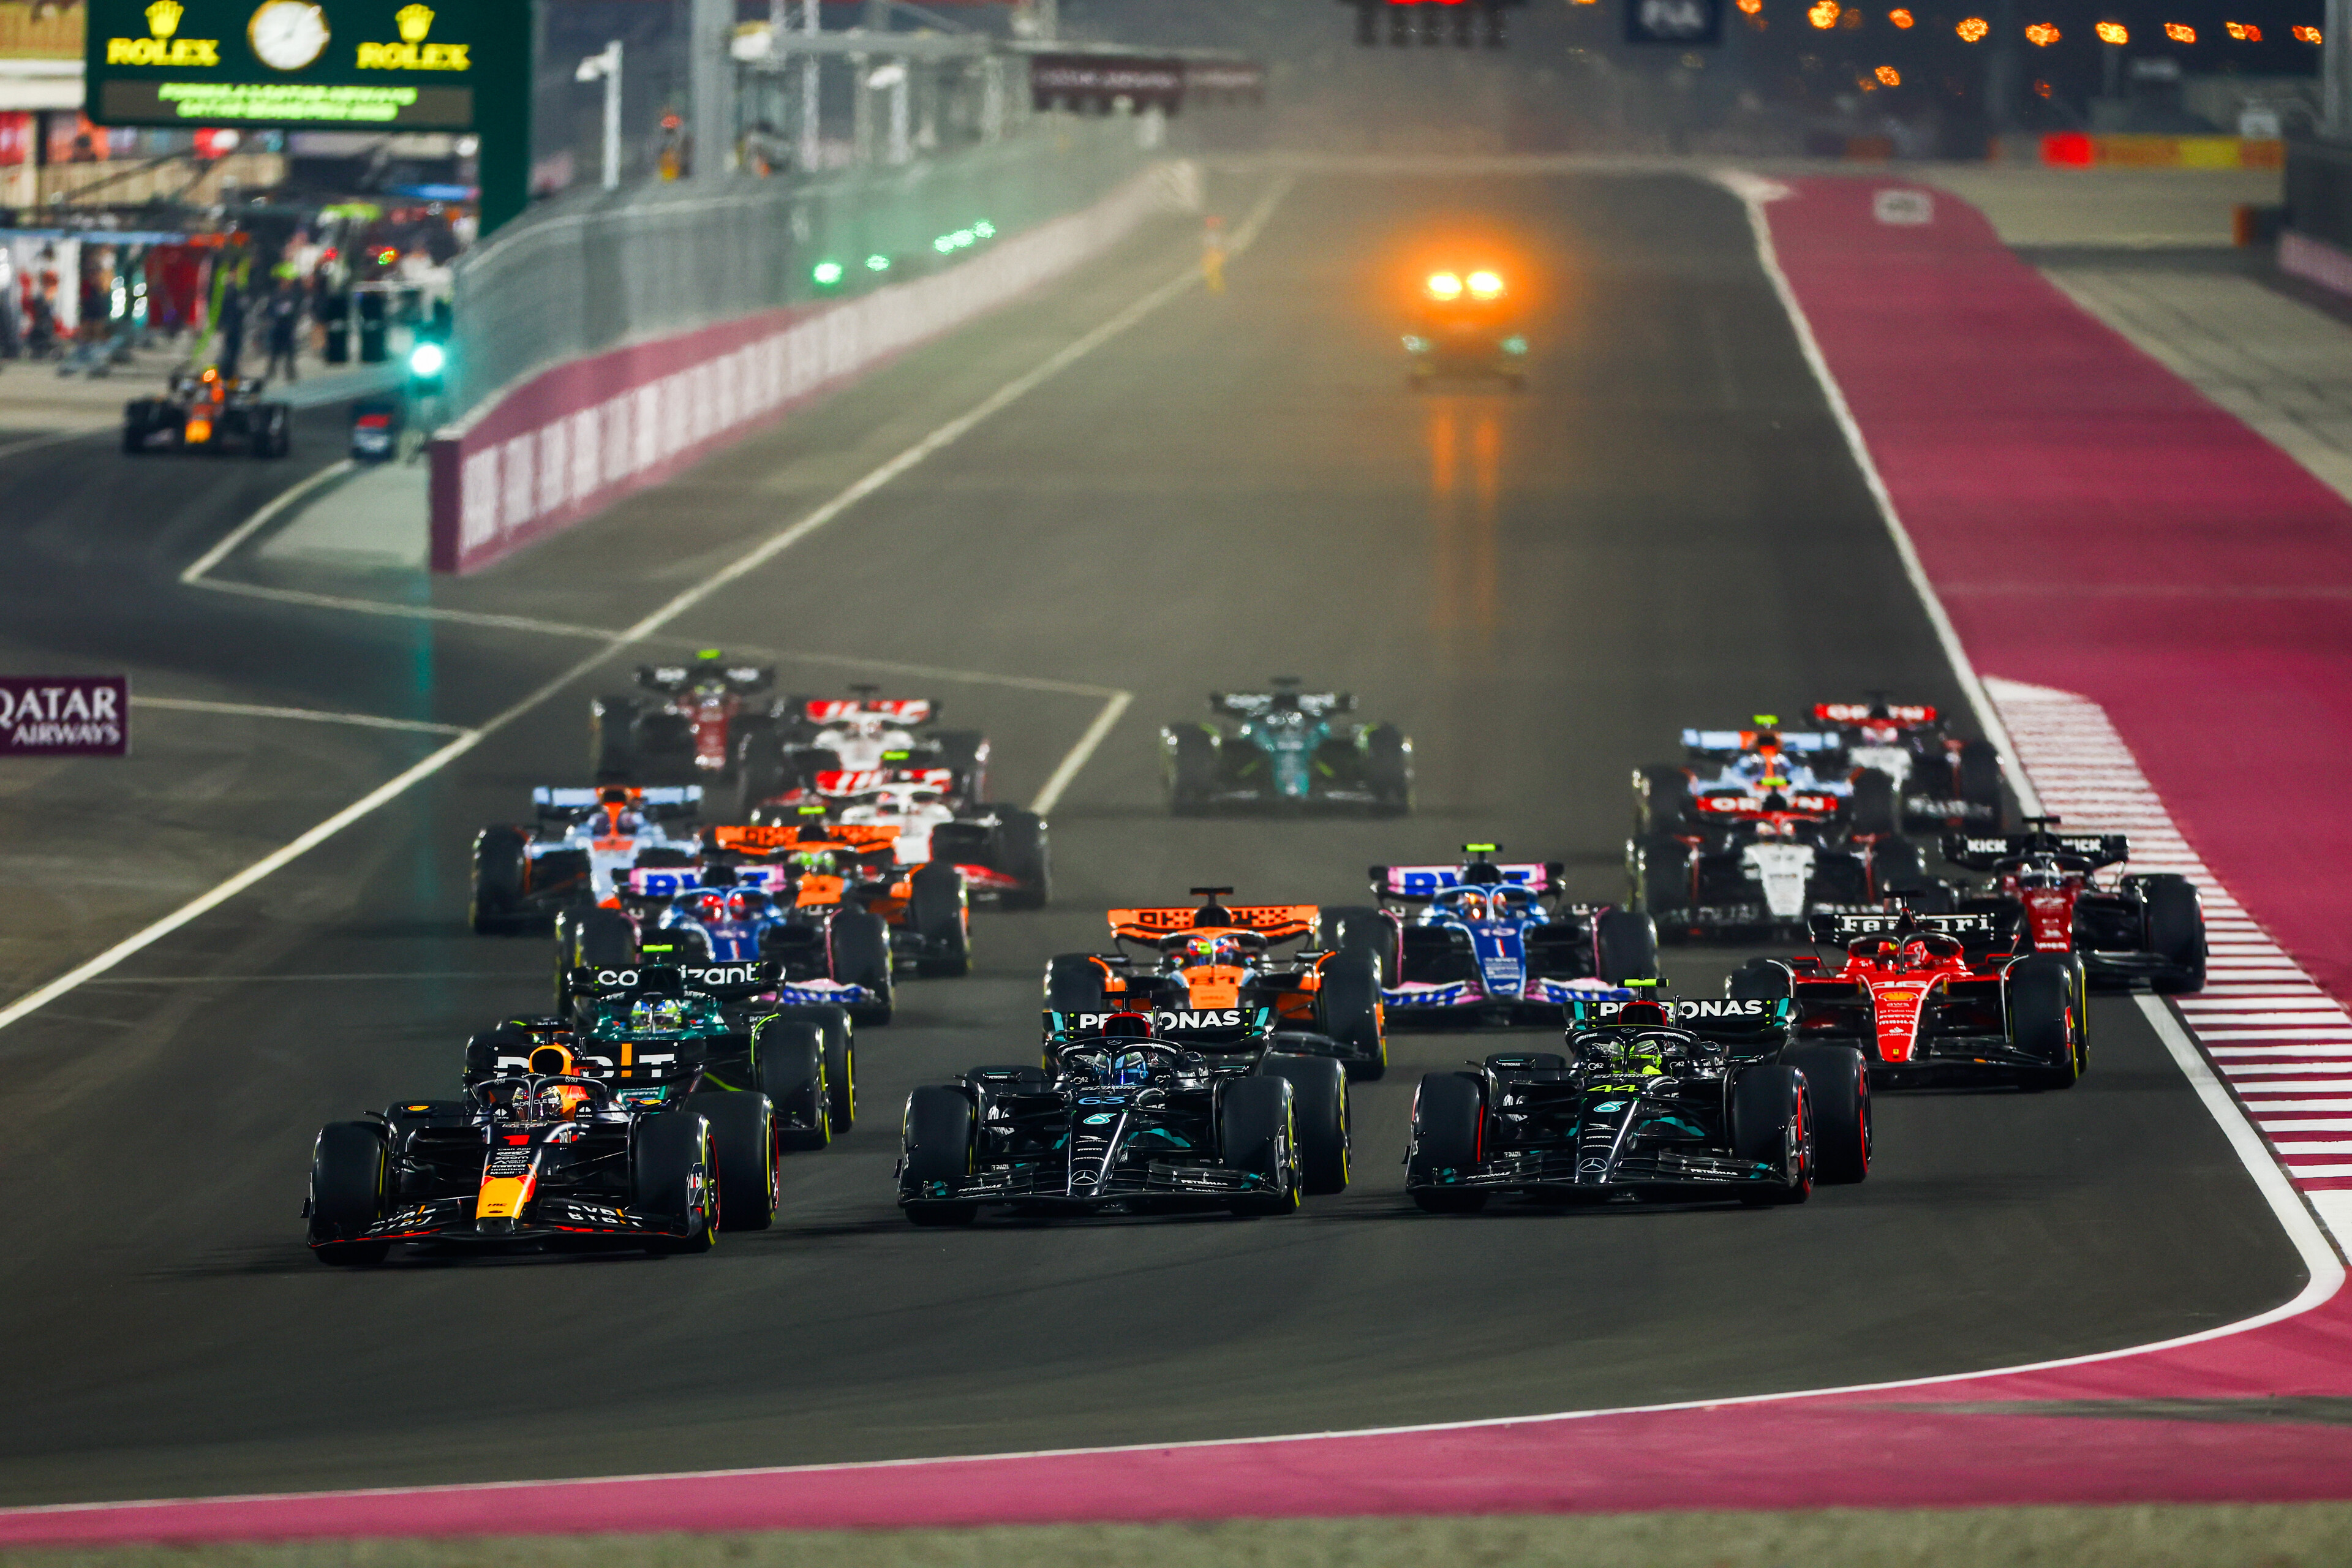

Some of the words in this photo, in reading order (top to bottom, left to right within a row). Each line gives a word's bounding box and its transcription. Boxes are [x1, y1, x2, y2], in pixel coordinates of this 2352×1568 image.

[107, 38, 221, 66] ROLEX
[355, 42, 471, 70] ROLEX
[11, 722, 121, 745] AIRWAYS
[1967, 839, 2007, 853] KICK
[1840, 915, 1989, 932] Ferari
[598, 962, 756, 986] coizant
[1871, 981, 1928, 989] 16
[1073, 1076, 1088, 1085] G42
[1078, 1096, 1125, 1105] 63
[503, 1134, 530, 1145] 1
[1466, 1171, 1511, 1180] PETRONAS
[957, 1183, 1002, 1192] PETRONAS
